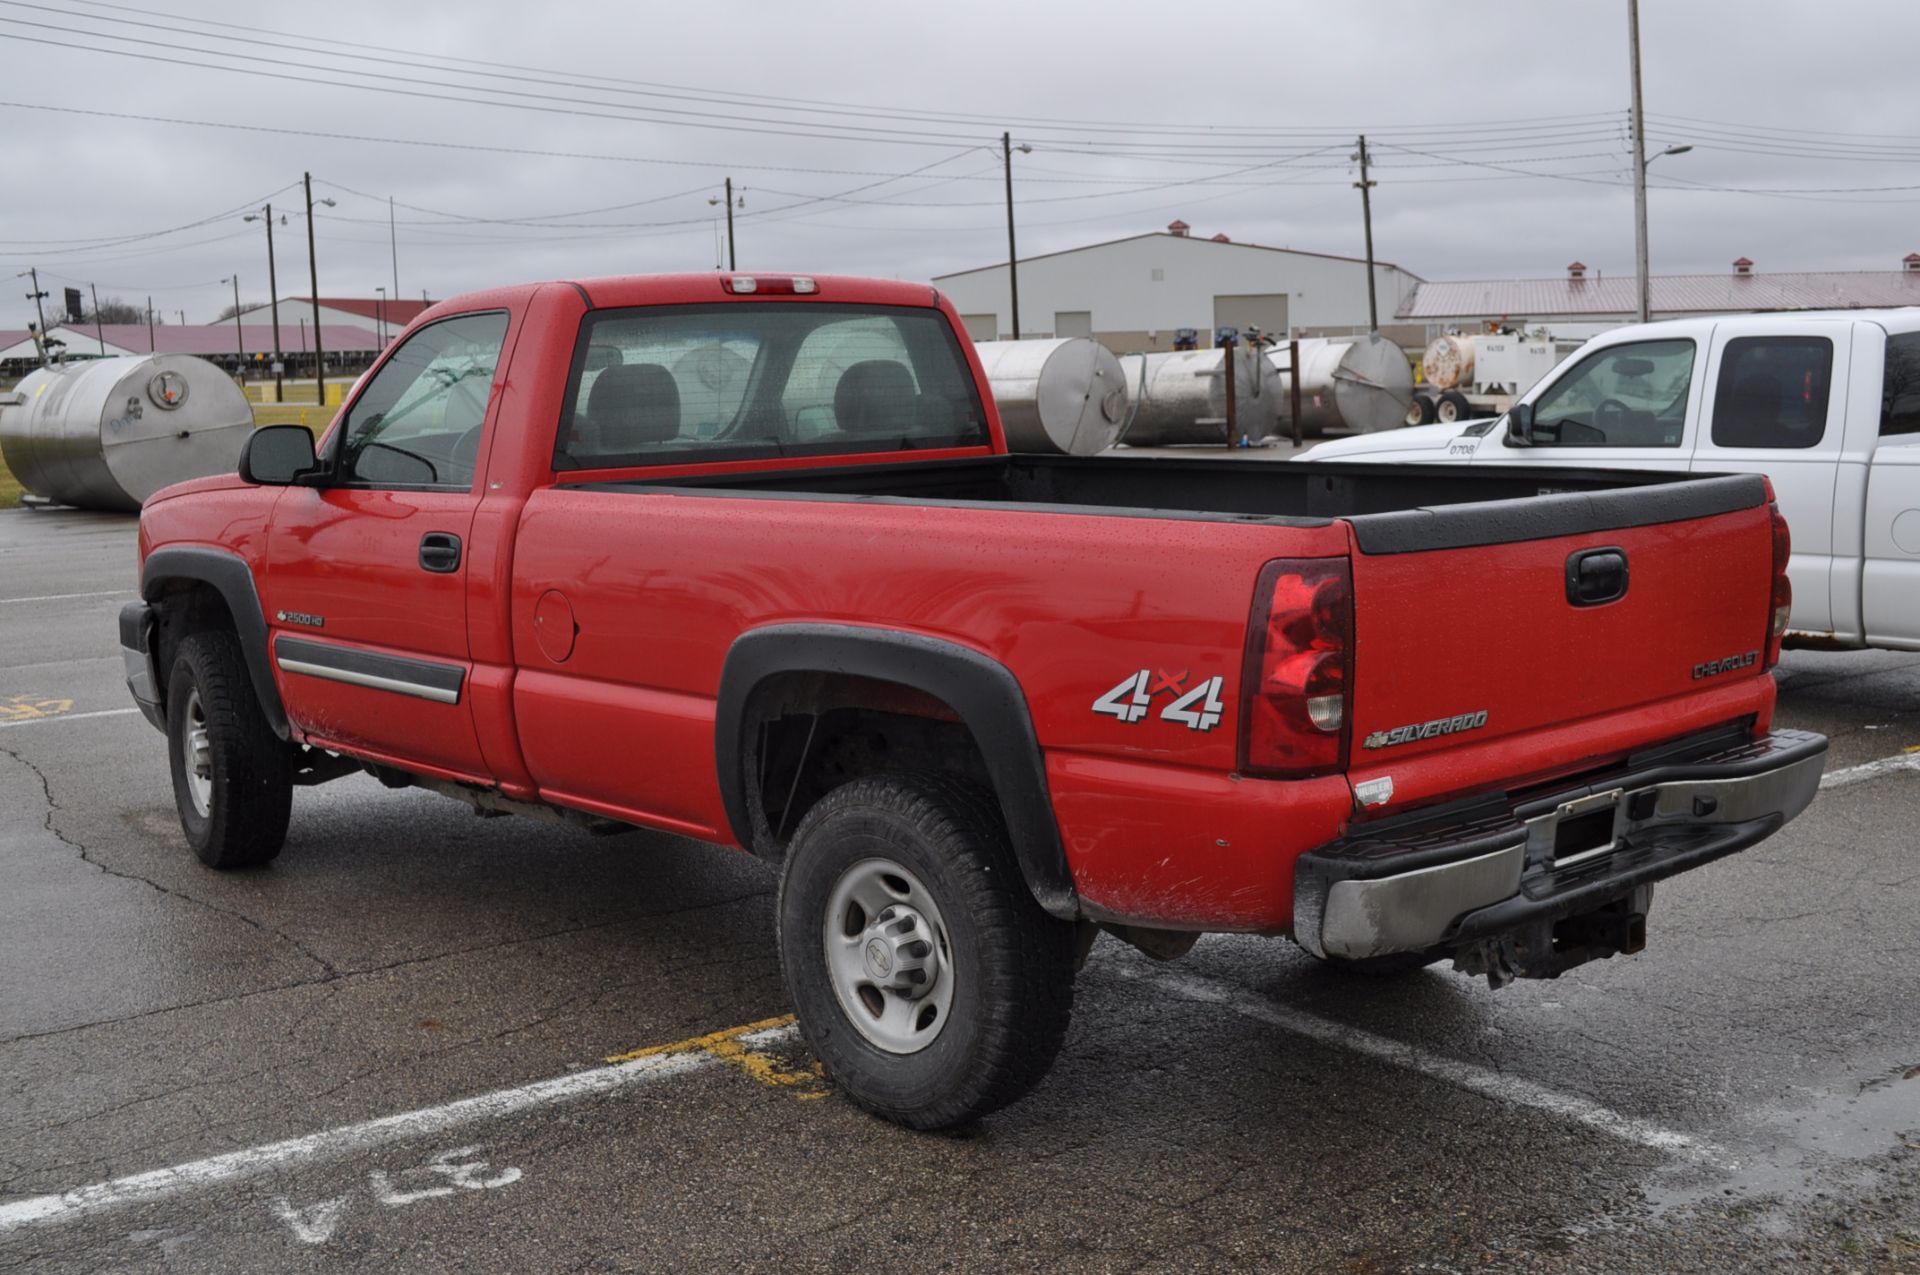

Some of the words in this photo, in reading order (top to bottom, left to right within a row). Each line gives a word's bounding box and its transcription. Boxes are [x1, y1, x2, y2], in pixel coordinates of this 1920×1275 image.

[1449, 444, 1476, 455] 0708
[287, 611, 311, 625] 2500
[311, 616, 323, 627] HD
[1693, 650, 1760, 681] CHEVROLET
[1386, 710, 1489, 746] SILVERADO
